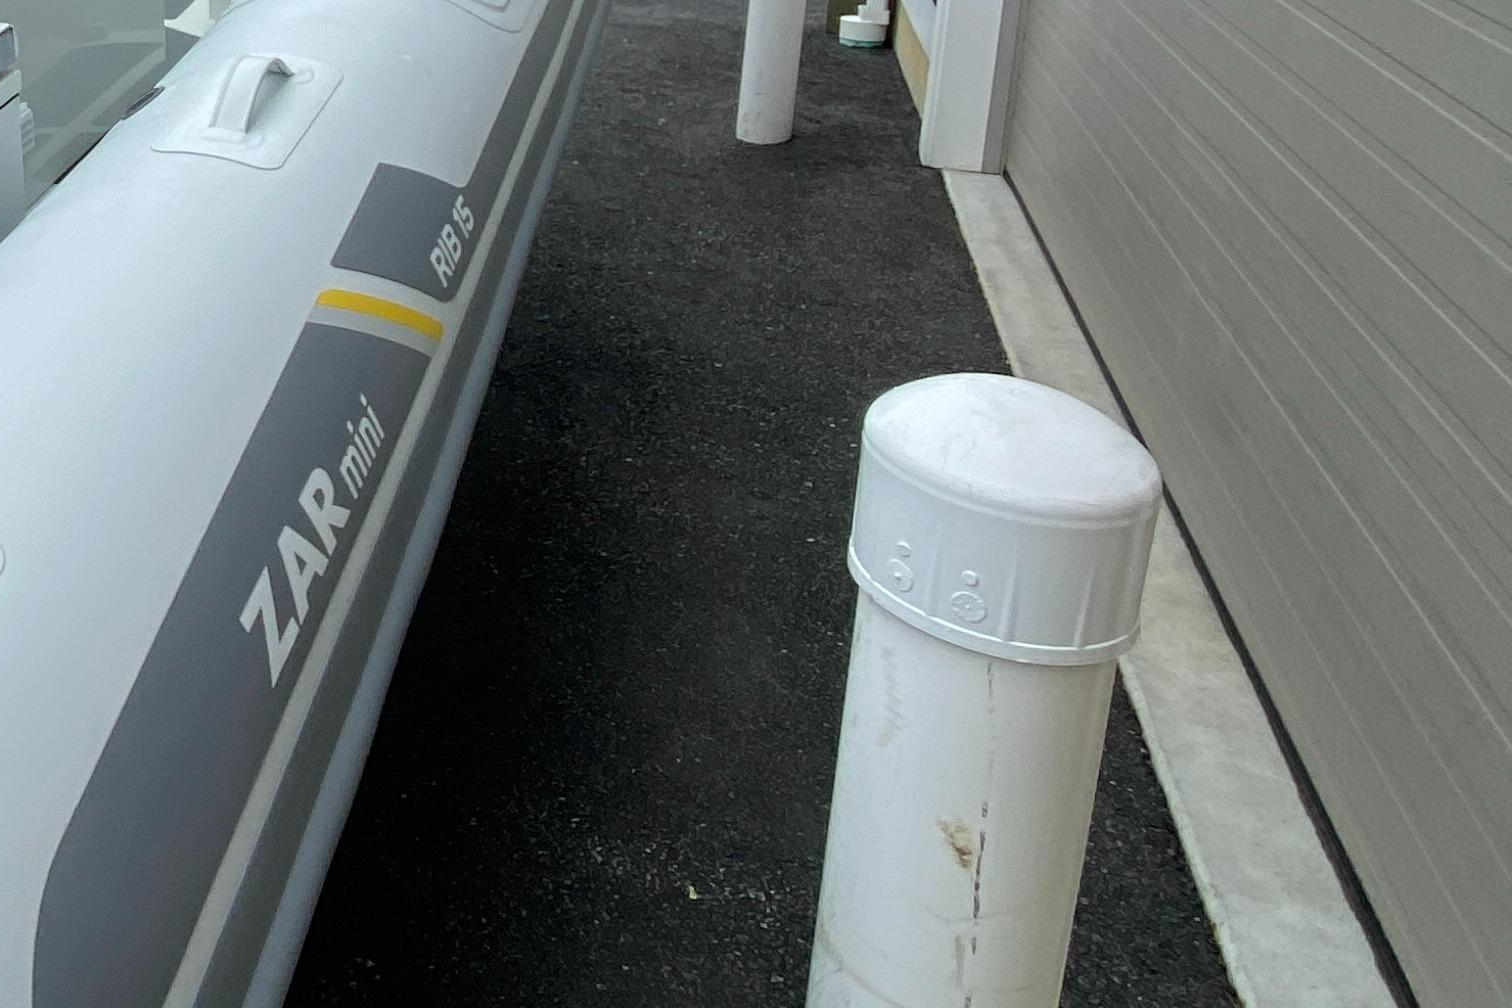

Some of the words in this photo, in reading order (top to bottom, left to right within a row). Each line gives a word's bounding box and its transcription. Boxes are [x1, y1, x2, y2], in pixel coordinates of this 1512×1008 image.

[430, 223, 462, 288] RIB
[452, 194, 474, 239] 15
[239, 467, 352, 688] ZAR
[339, 392, 385, 499] mini
